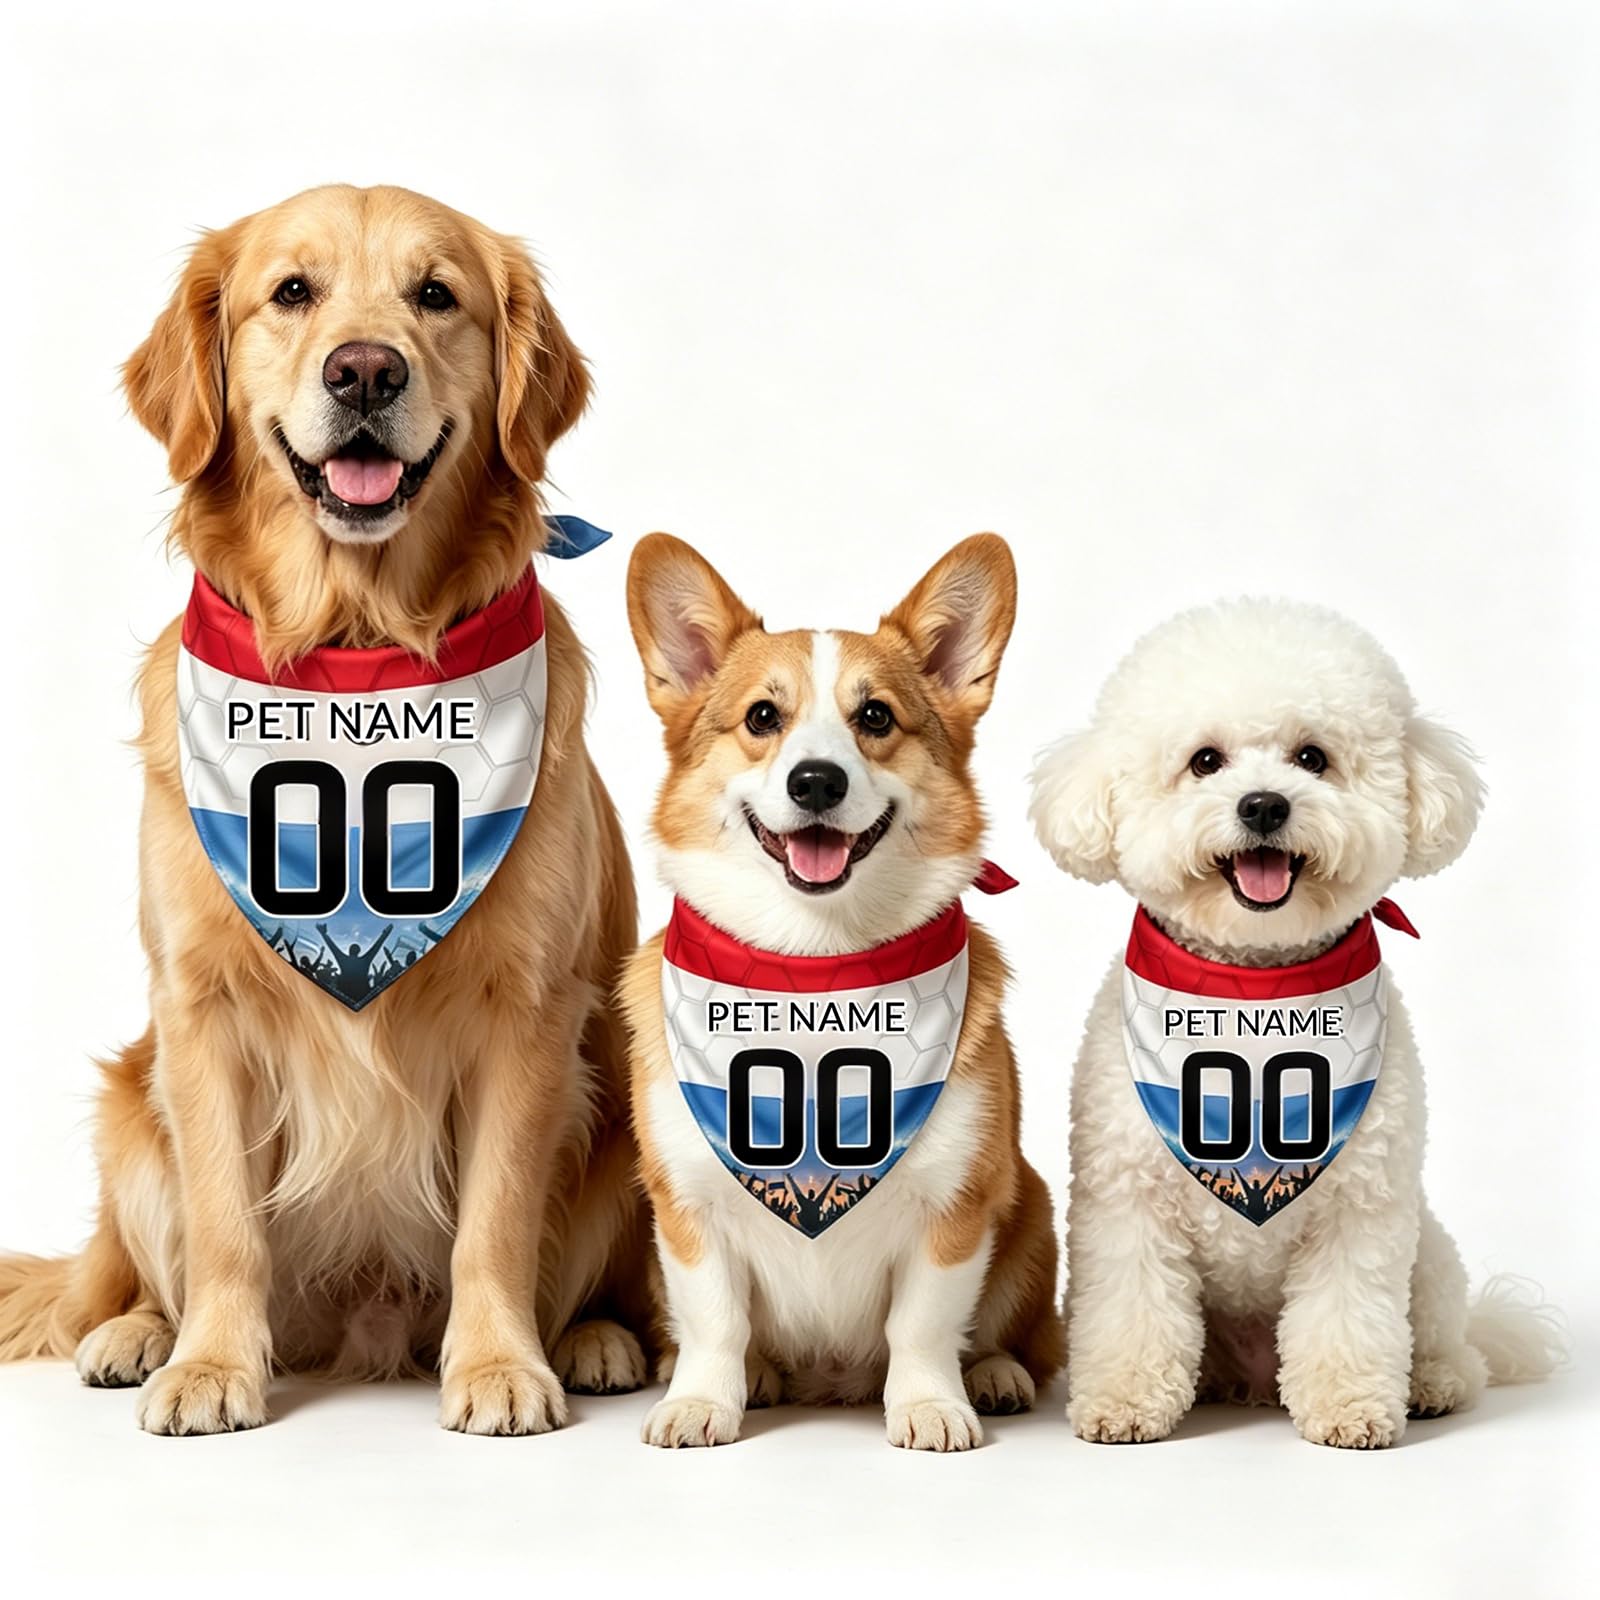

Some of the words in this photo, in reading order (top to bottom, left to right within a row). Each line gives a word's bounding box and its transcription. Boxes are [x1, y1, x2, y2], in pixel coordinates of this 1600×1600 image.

[228, 701, 315, 740] PET
[329, 701, 475, 740] NAME
[249, 760, 461, 916] 00
[708, 1001, 778, 1033] PET
[790, 1001, 906, 1033] NAME
[1165, 1009, 1227, 1037] PET
[1237, 1008, 1342, 1037] NAME
[728, 1047, 893, 1167] 00
[1181, 1051, 1331, 1161] 00
